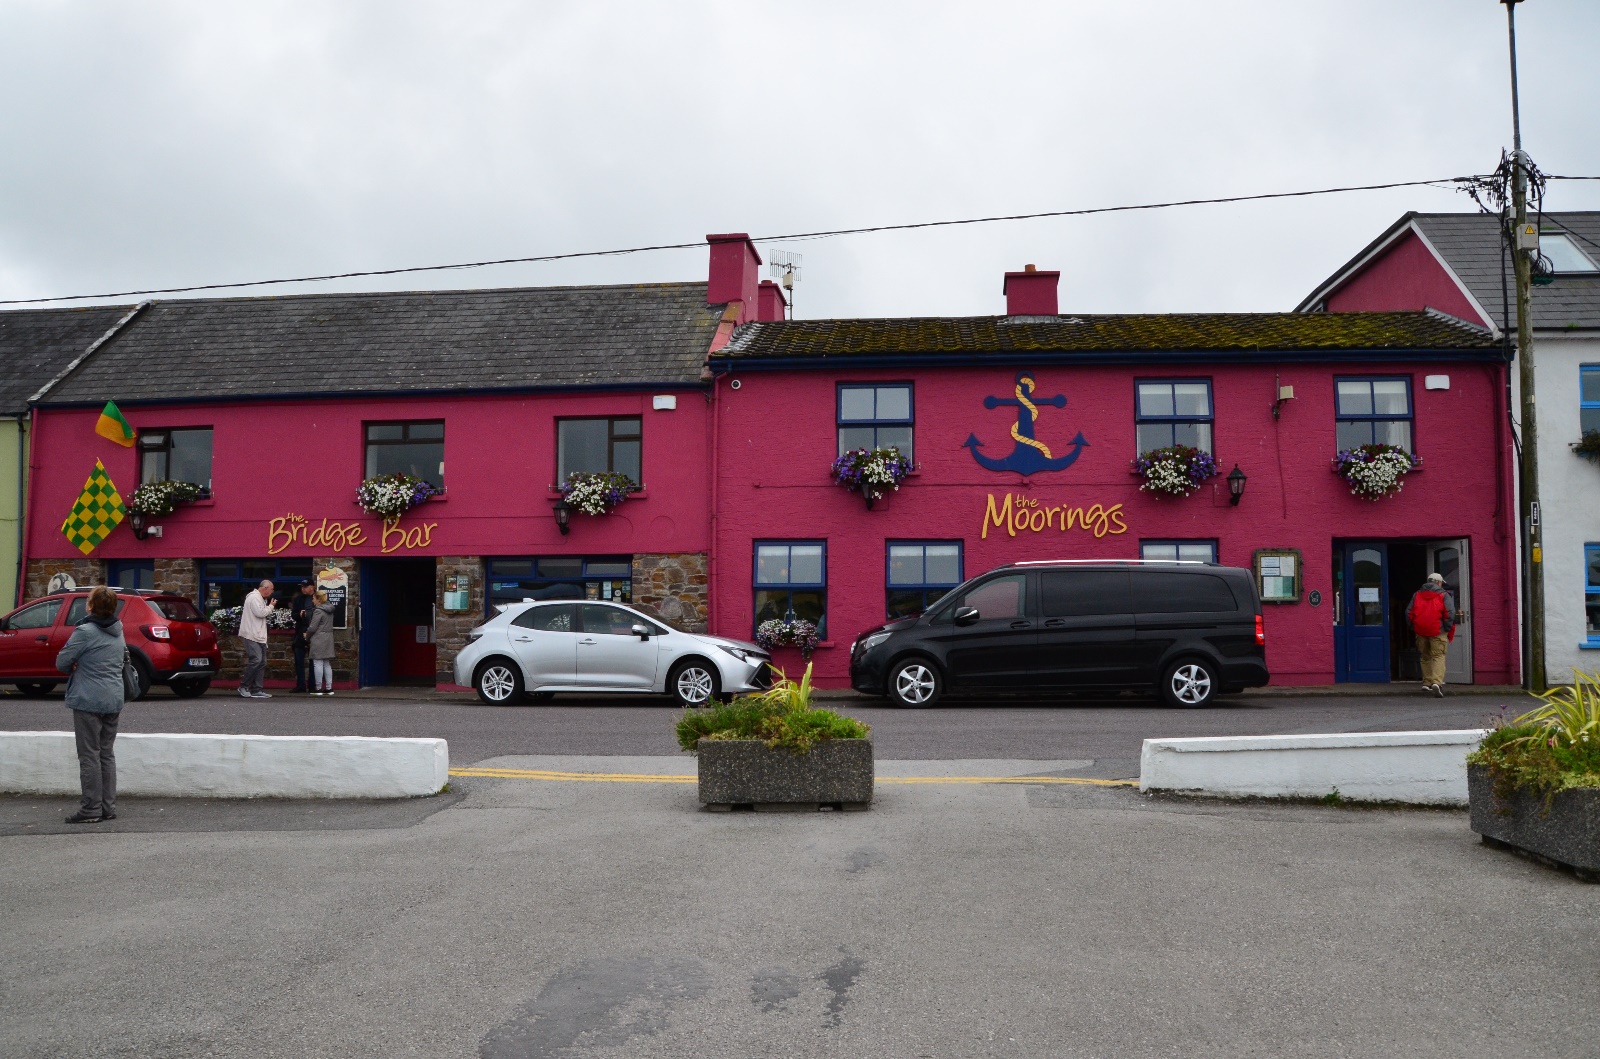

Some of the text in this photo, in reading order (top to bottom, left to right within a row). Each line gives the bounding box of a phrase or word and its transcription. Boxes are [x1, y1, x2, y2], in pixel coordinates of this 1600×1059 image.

[1014, 493, 1040, 508] the
[285, 512, 305, 523] the
[981, 492, 1128, 539] Moorings
[267, 514, 438, 555] Bridge Bar
